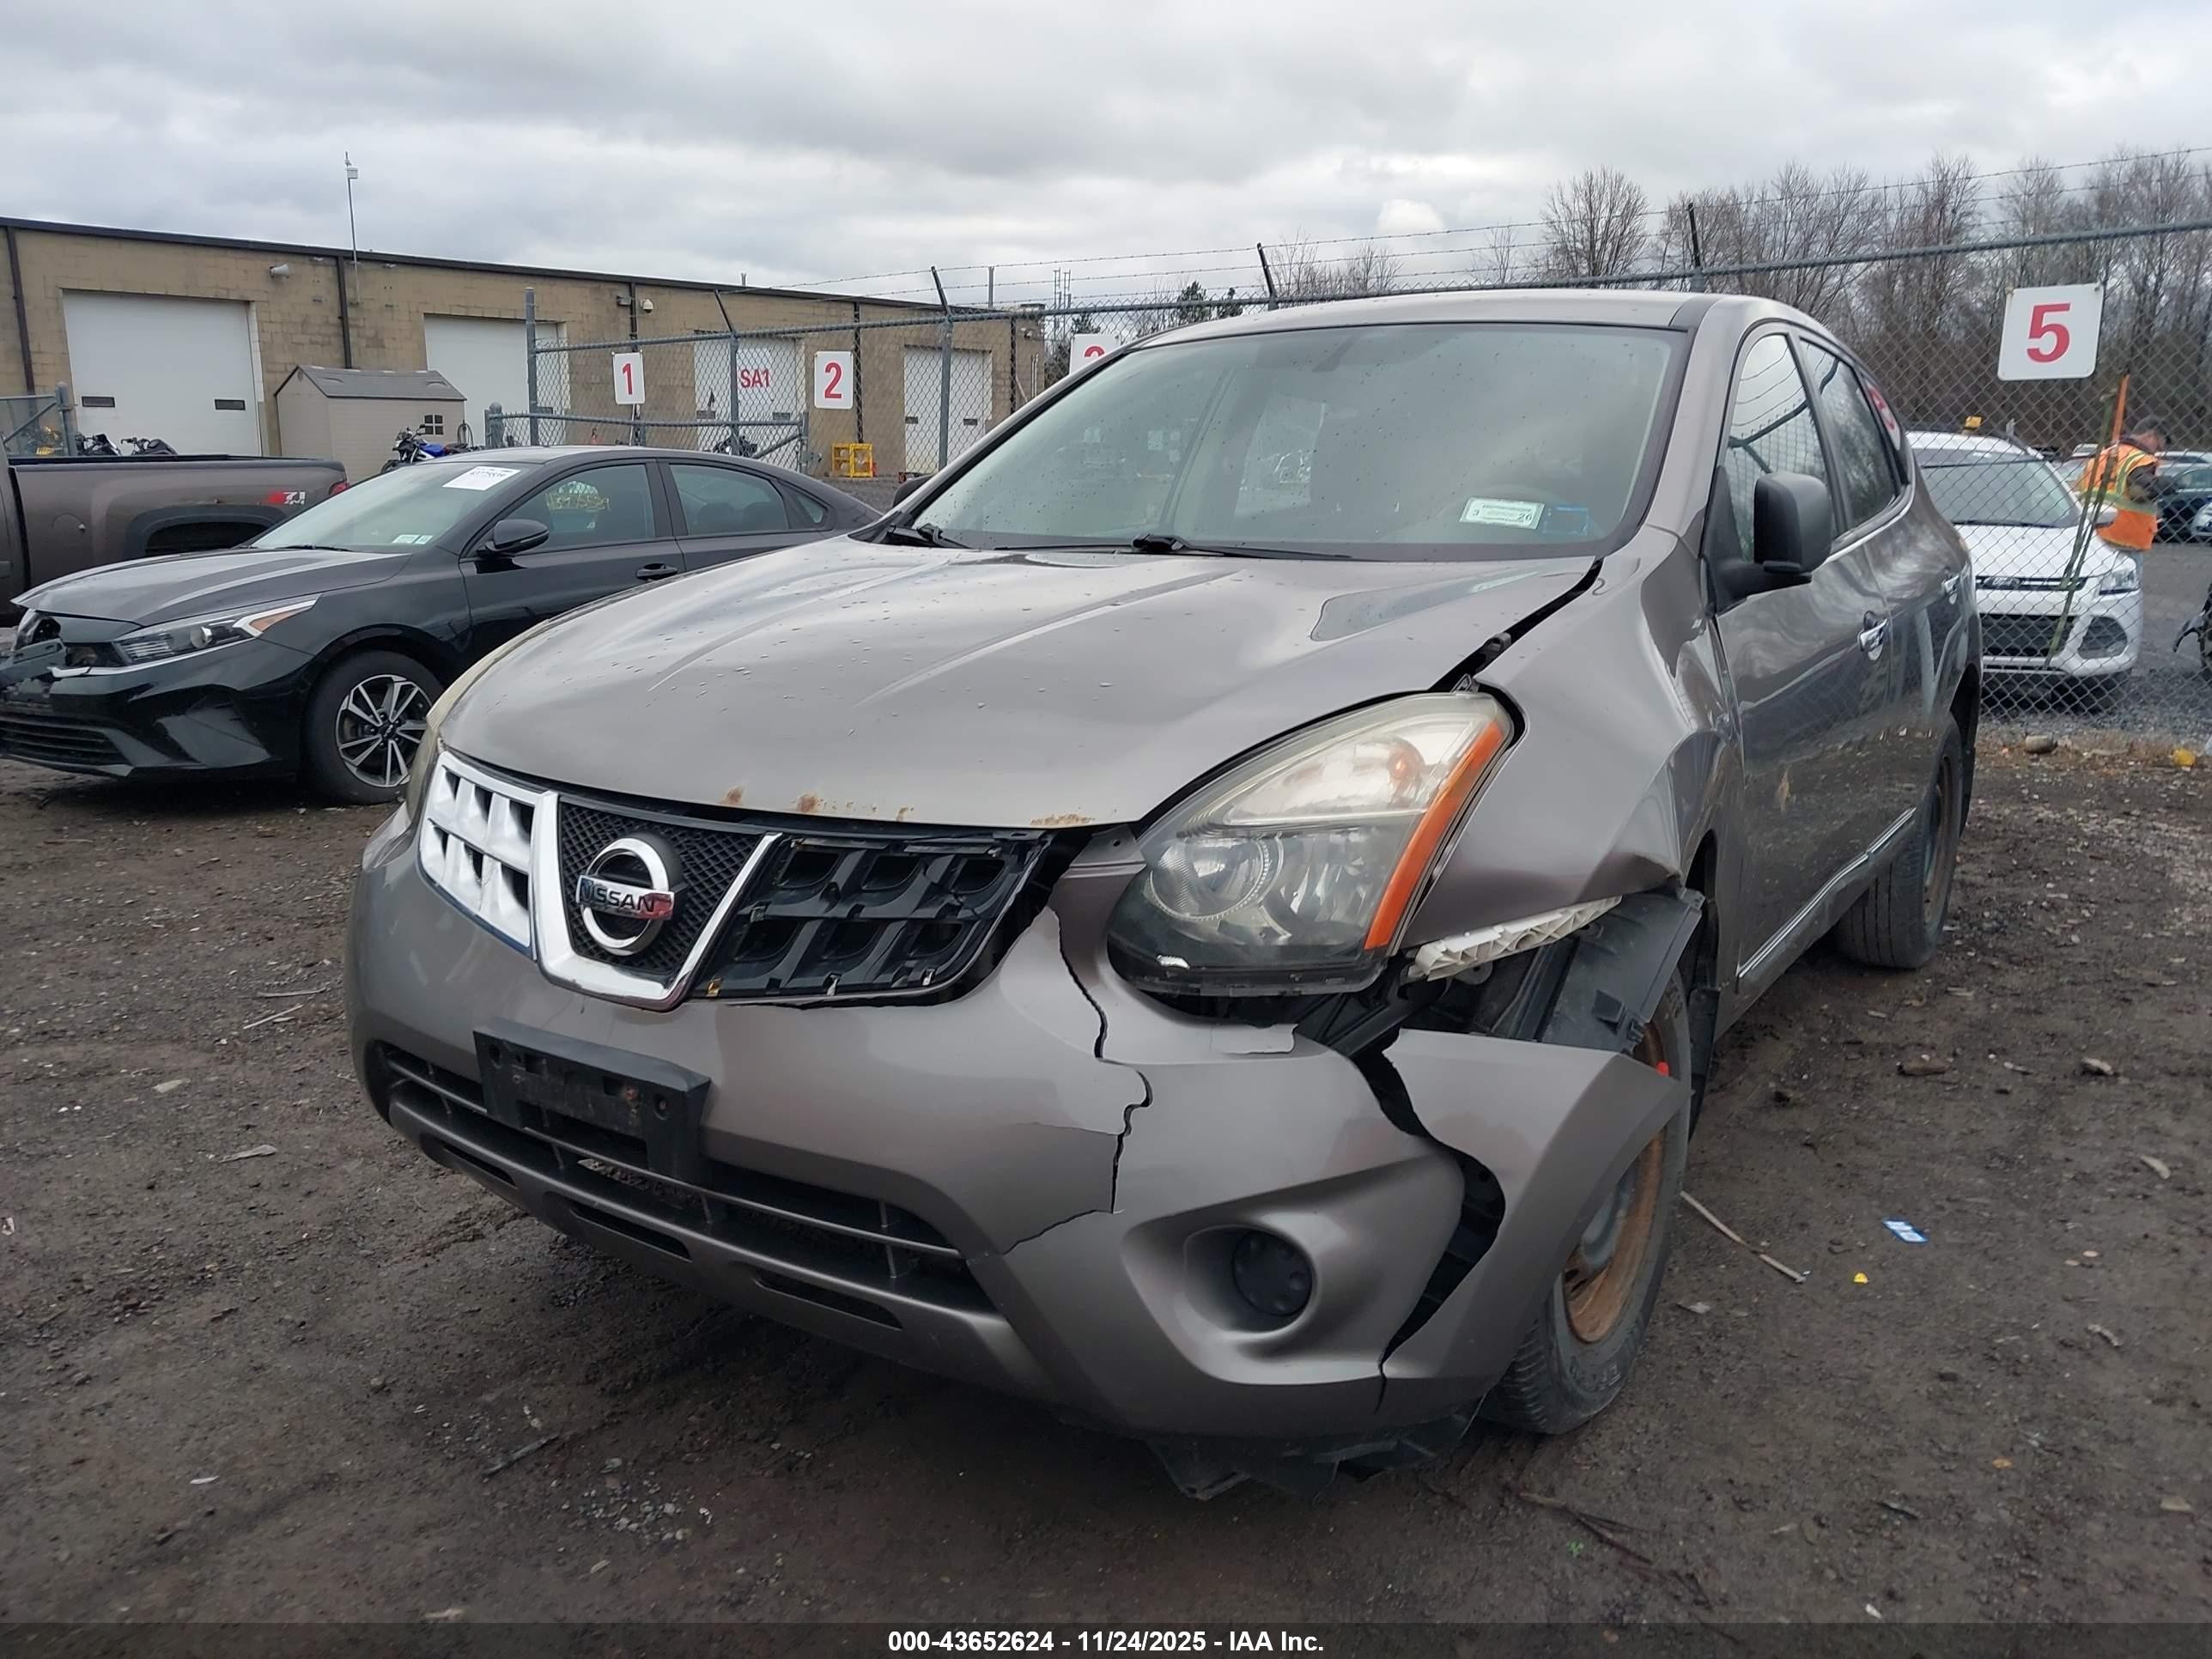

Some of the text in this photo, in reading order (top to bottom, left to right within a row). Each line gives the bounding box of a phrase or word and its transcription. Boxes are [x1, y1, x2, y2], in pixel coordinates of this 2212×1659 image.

[2027, 302, 2071, 363] 5
[622, 362, 633, 395] 1
[739, 368, 770, 388] SA1
[824, 362, 843, 399] 2
[580, 883, 655, 913] NISSAN
